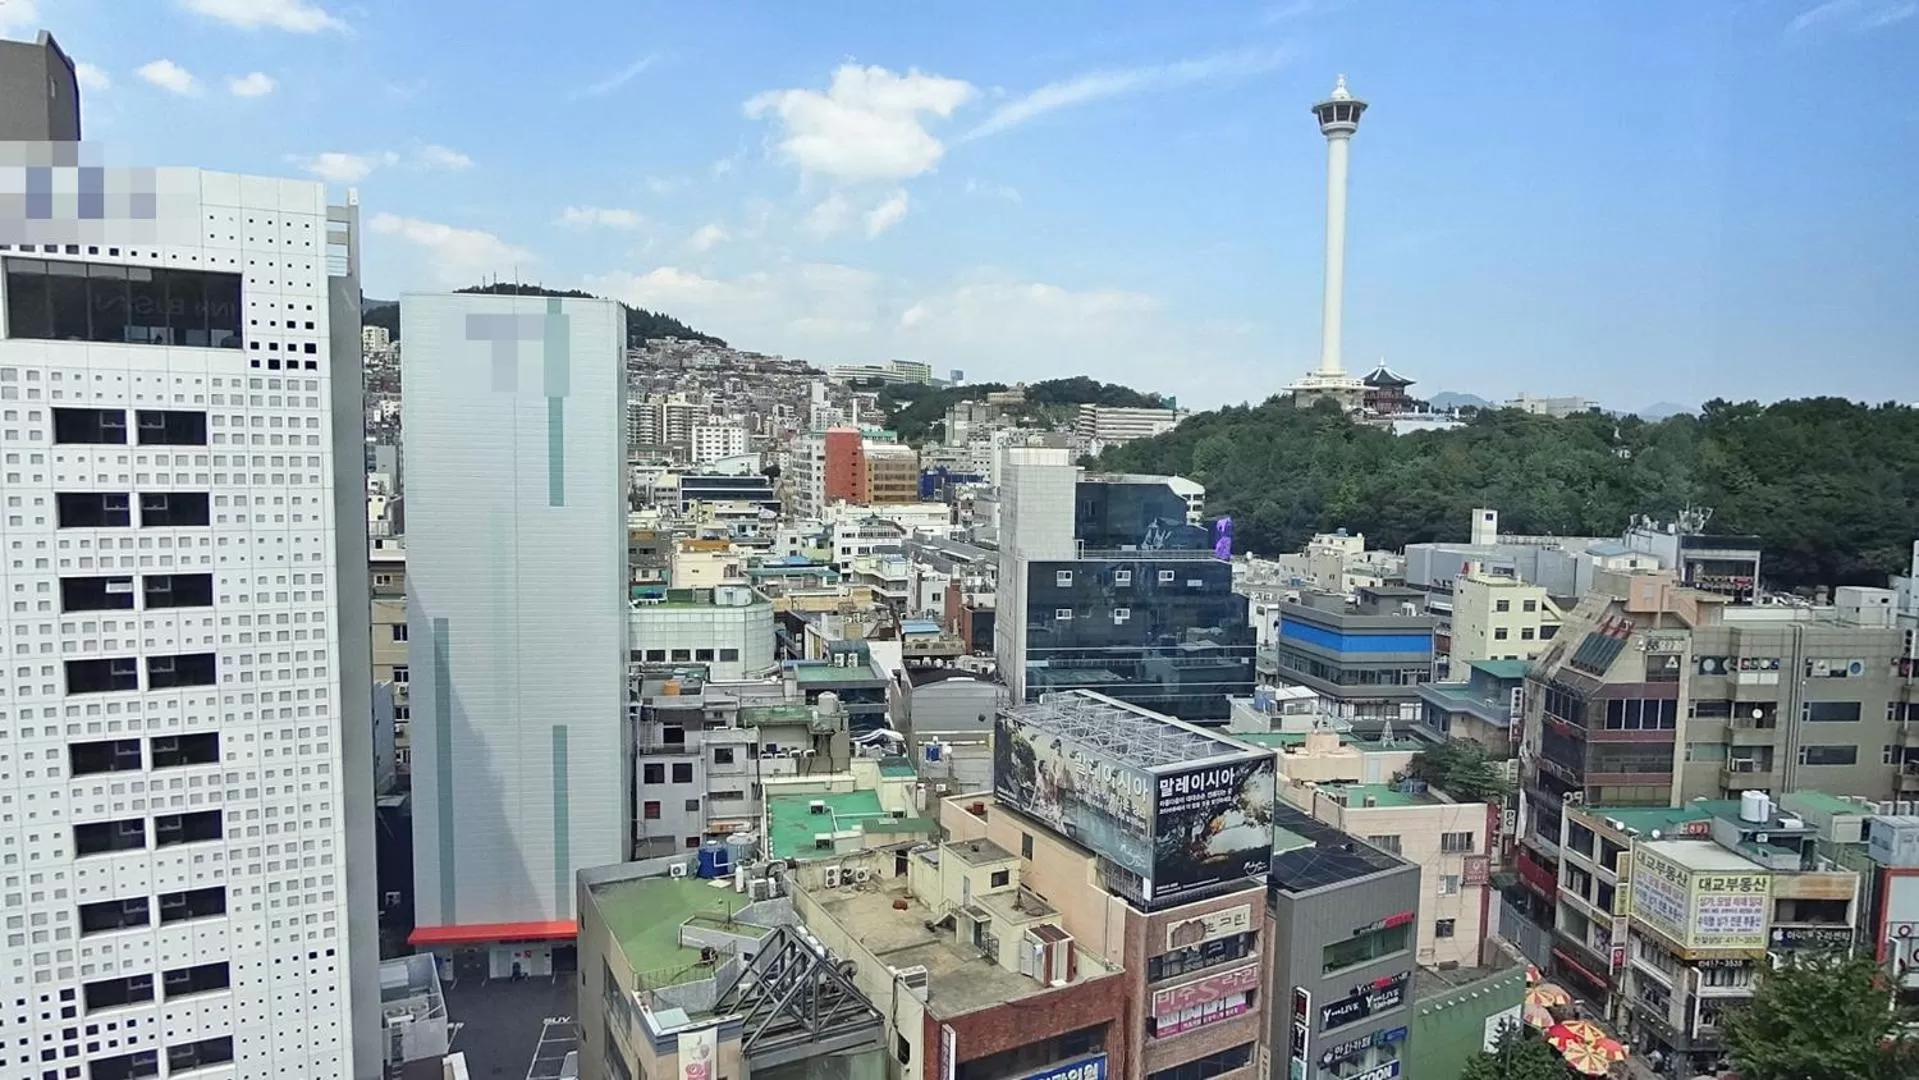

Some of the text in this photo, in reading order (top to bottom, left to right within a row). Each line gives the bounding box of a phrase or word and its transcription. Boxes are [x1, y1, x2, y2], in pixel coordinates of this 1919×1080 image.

[1075, 751, 1149, 801] 말레이시아
[1160, 767, 1235, 798] 말레이시아
[1636, 850, 1689, 888] 대교부동산
[1698, 877, 1767, 892] 대교부동산
[543, 1016, 571, 1025] SUV
